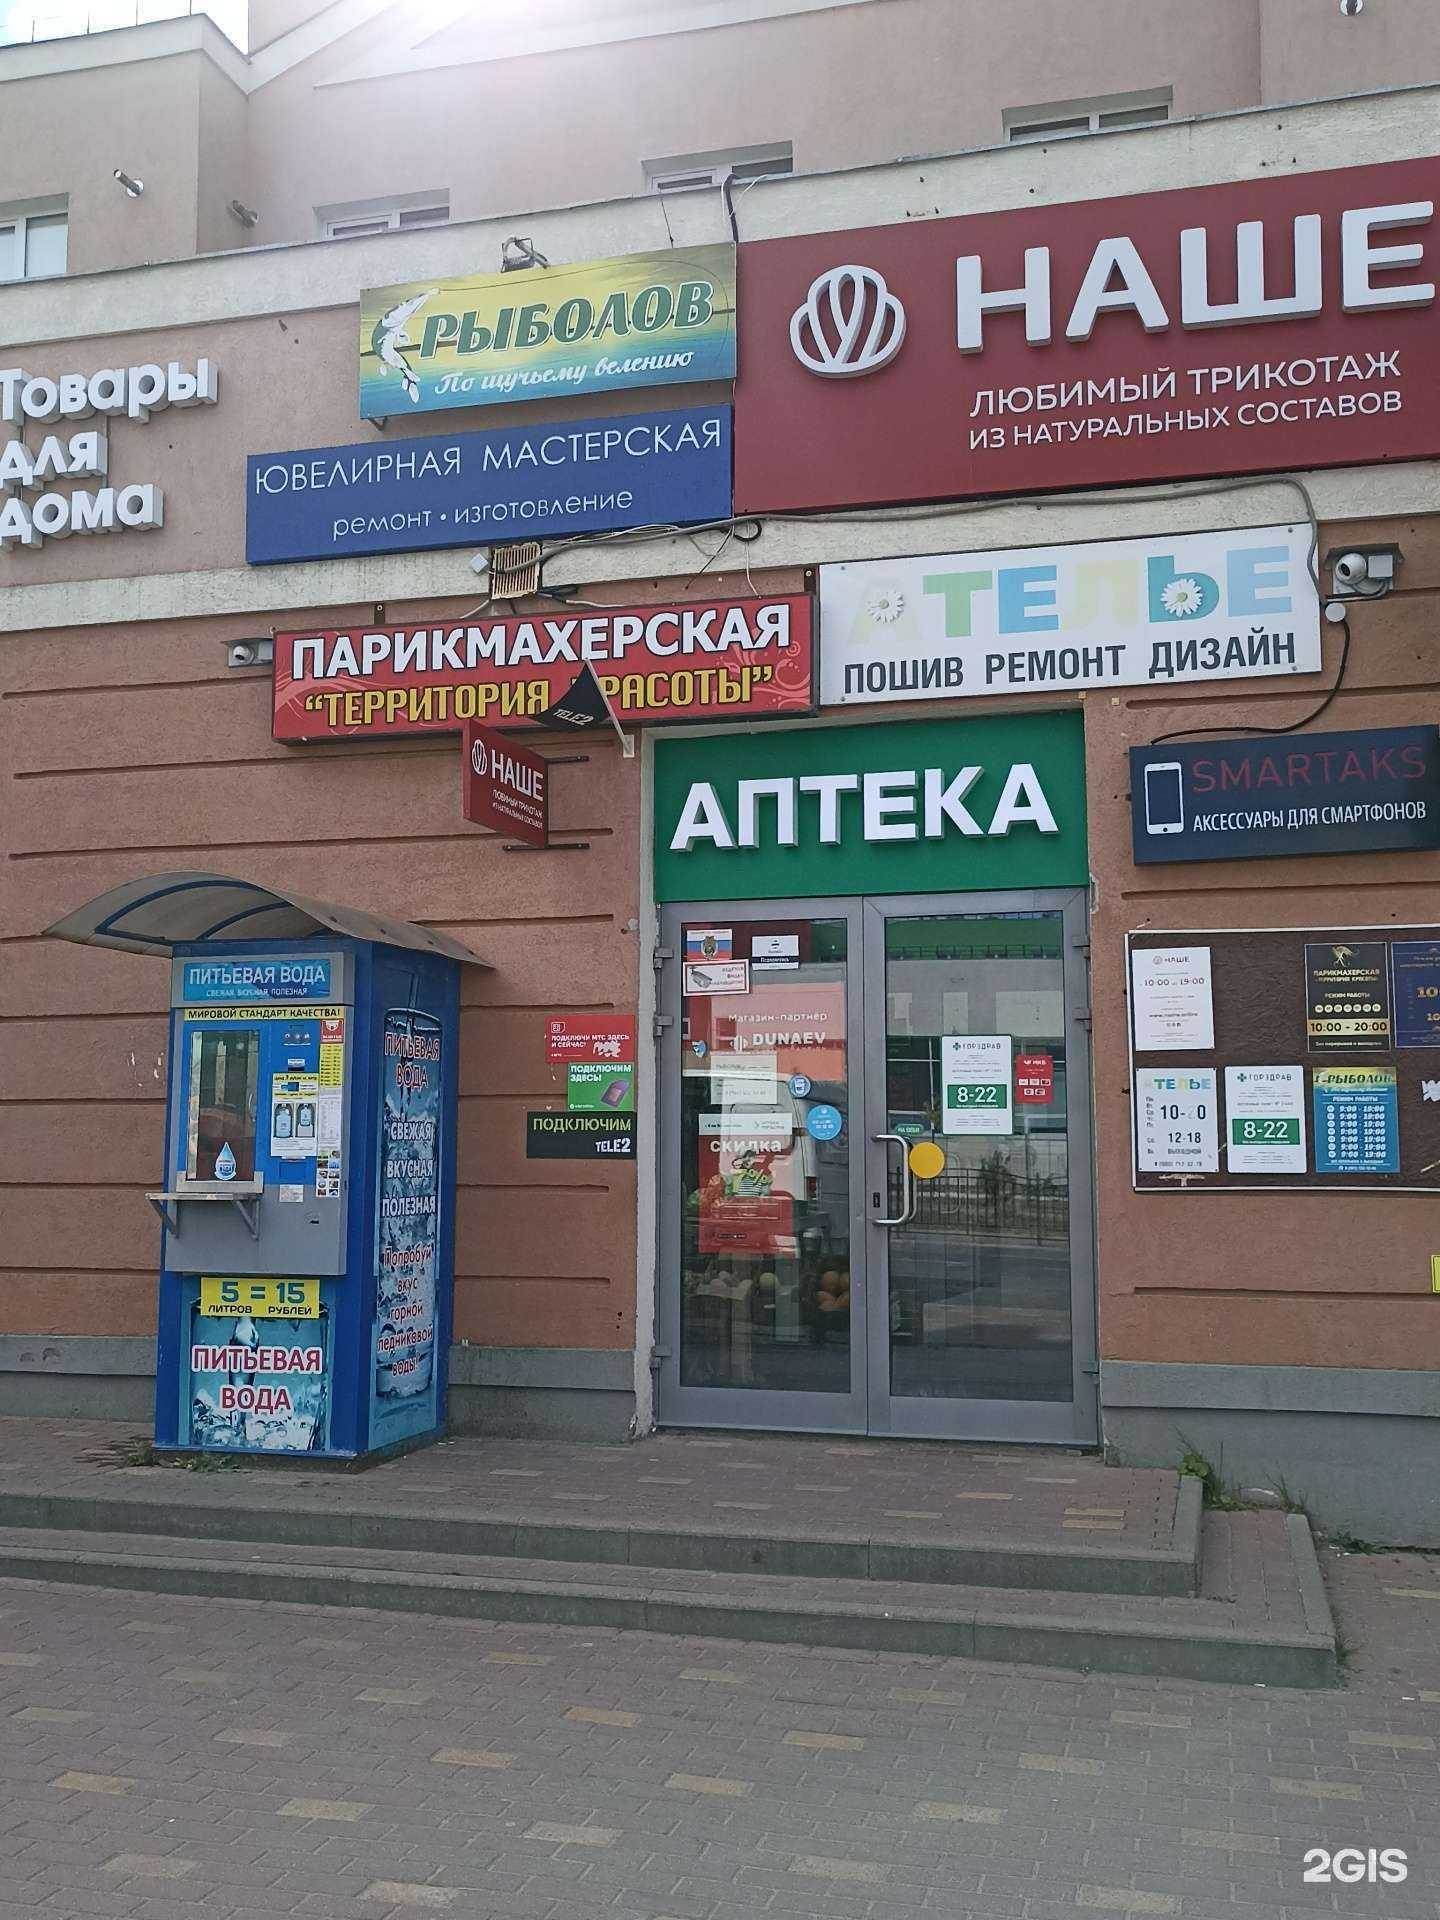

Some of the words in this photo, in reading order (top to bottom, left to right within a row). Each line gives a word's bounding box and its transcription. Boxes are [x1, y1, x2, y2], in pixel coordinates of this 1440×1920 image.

[956, 201, 1435, 354] НАШЕ
[420, 281, 713, 359] РЫБОЛОВ
[434, 371, 474, 395] По
[480, 362, 587, 395] щучьему
[595, 348, 694, 377] велению
[970, 367, 1176, 417] ЛЮБИМЫЙ
[1187, 350, 1401, 397] ТРИКОТАЖ
[0, 358, 211, 421] Товары
[968, 427, 1006, 450] ИЗ
[1012, 409, 1229, 446] НАТУРАЛЬНЫХ
[1236, 390, 1402, 426] СОСТАВОВ
[0, 431, 101, 487] для
[255, 448, 462, 495] ЮВЕЛИРНАЯ
[482, 419, 722, 470] МАСТЕРСКАЯ
[0, 484, 156, 546] дома
[332, 509, 432, 541] ремонт
[453, 488, 633, 524] изготовление
[846, 545, 1294, 646] АТЕЛЬЕ
[292, 604, 791, 680] ПАРИКМАХЕРСКАЯ
[843, 655, 964, 694] ПОШИВ
[985, 644, 1126, 686] РЕМОНТ
[1148, 627, 1296, 680] ДИЗАЙН
[571, 665, 773, 712] РАСОТЫ”
[553, 708, 594, 725] TELE2
[491, 749, 544, 801] НАШЕ
[1192, 746, 1426, 793] SMARTAKS
[669, 763, 1059, 851] АПТЕКА
[1193, 810, 1284, 832] АКСЕССУАРЫ
[1287, 807, 1318, 830] ДЛЯ
[1321, 801, 1426, 824] СМАРТФОНОВ
[189, 966, 275, 985] ПИТЬЕВАЯ
[280, 965, 325, 985] ВОДА
[1313, 968, 1380, 976] ПАРИКМАХЕРСКАЯ
[188, 1007, 237, 1018] МИРОВОЙ
[240, 1009, 287, 1019] СТАНДАРТ
[290, 1008, 340, 1017] КАЧЕСТВА!
[752, 1032, 826, 1046] DUNAEV
[1310, 1022, 1342, 1032] 10:00
[1354, 1021, 1387, 1031] 20:00
[384, 1031, 440, 1062] ПИТЬЕВАЯ
[396, 1064, 429, 1092] ВОДА
[570, 1065, 631, 1073] ПОДКЛЮЧИМ
[1327, 1074, 1393, 1084] РЫБОЛОВ
[957, 1087, 997, 1103] 8-22
[390, 1121, 432, 1141] СВЕЖАЯ
[533, 1118, 631, 1133] ПОДКЛЮЧИМ
[1168, 1132, 1201, 1143] 12-18
[1244, 1121, 1288, 1138] 8-22
[595, 1138, 631, 1153] TELE2
[710, 1141, 782, 1154] скидка
[386, 1160, 433, 1178] ВКУСНАЯ
[382, 1196, 436, 1217] ПОЛЕЗНАЯ
[384, 1243, 432, 1267] Попробуй
[221, 1281, 239, 1303] 5
[251, 1286, 266, 1299] =
[276, 1282, 305, 1303] 15
[397, 1279, 418, 1294] вкус
[208, 1304, 252, 1313] ЛИТРОВ
[268, 1306, 312, 1315] РУБЛЕЙ
[390, 1301, 424, 1321] горной
[193, 1347, 322, 1373] ПИТЬЕВАЯ
[220, 1388, 291, 1414] ВОДА
